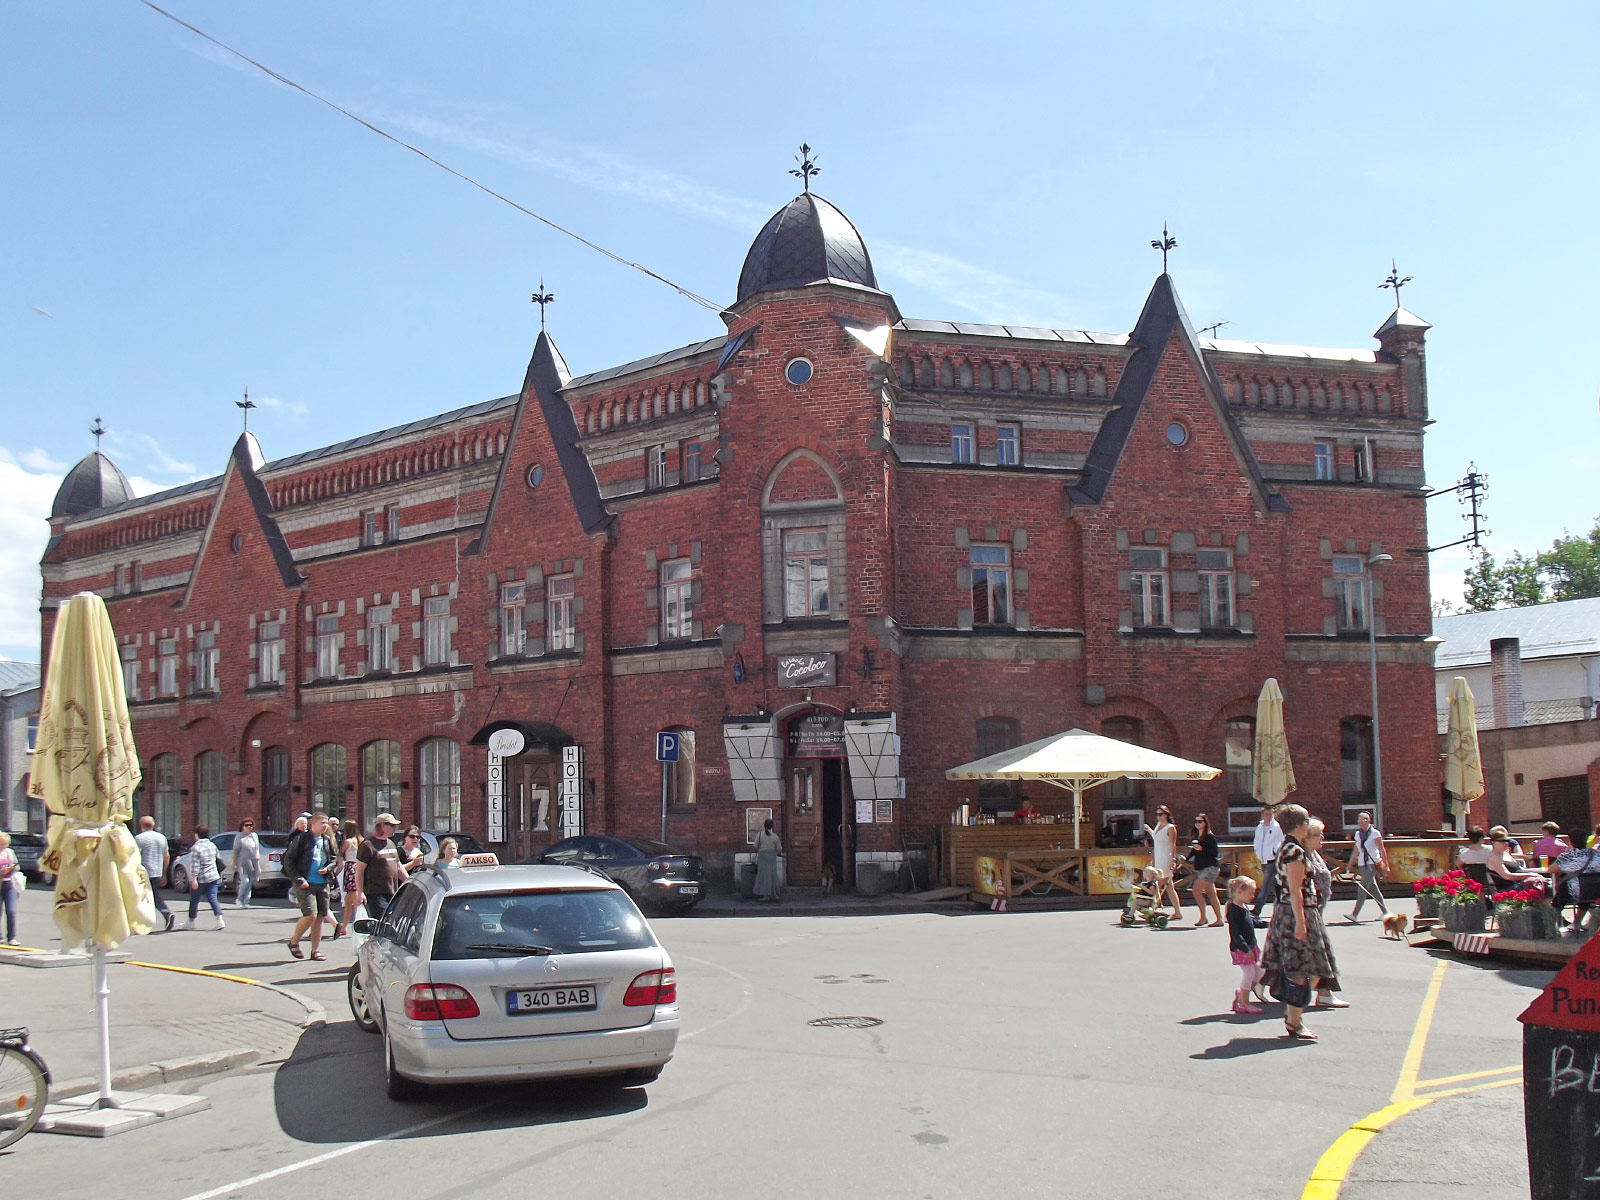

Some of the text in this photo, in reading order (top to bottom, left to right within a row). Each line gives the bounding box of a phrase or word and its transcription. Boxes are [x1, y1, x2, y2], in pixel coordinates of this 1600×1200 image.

[786, 657, 827, 678] Cocoloco
[662, 735, 675, 758] P
[491, 752, 500, 840] HOTELL
[464, 856, 495, 865] TAKSO
[523, 989, 590, 1007] 340 BAB
